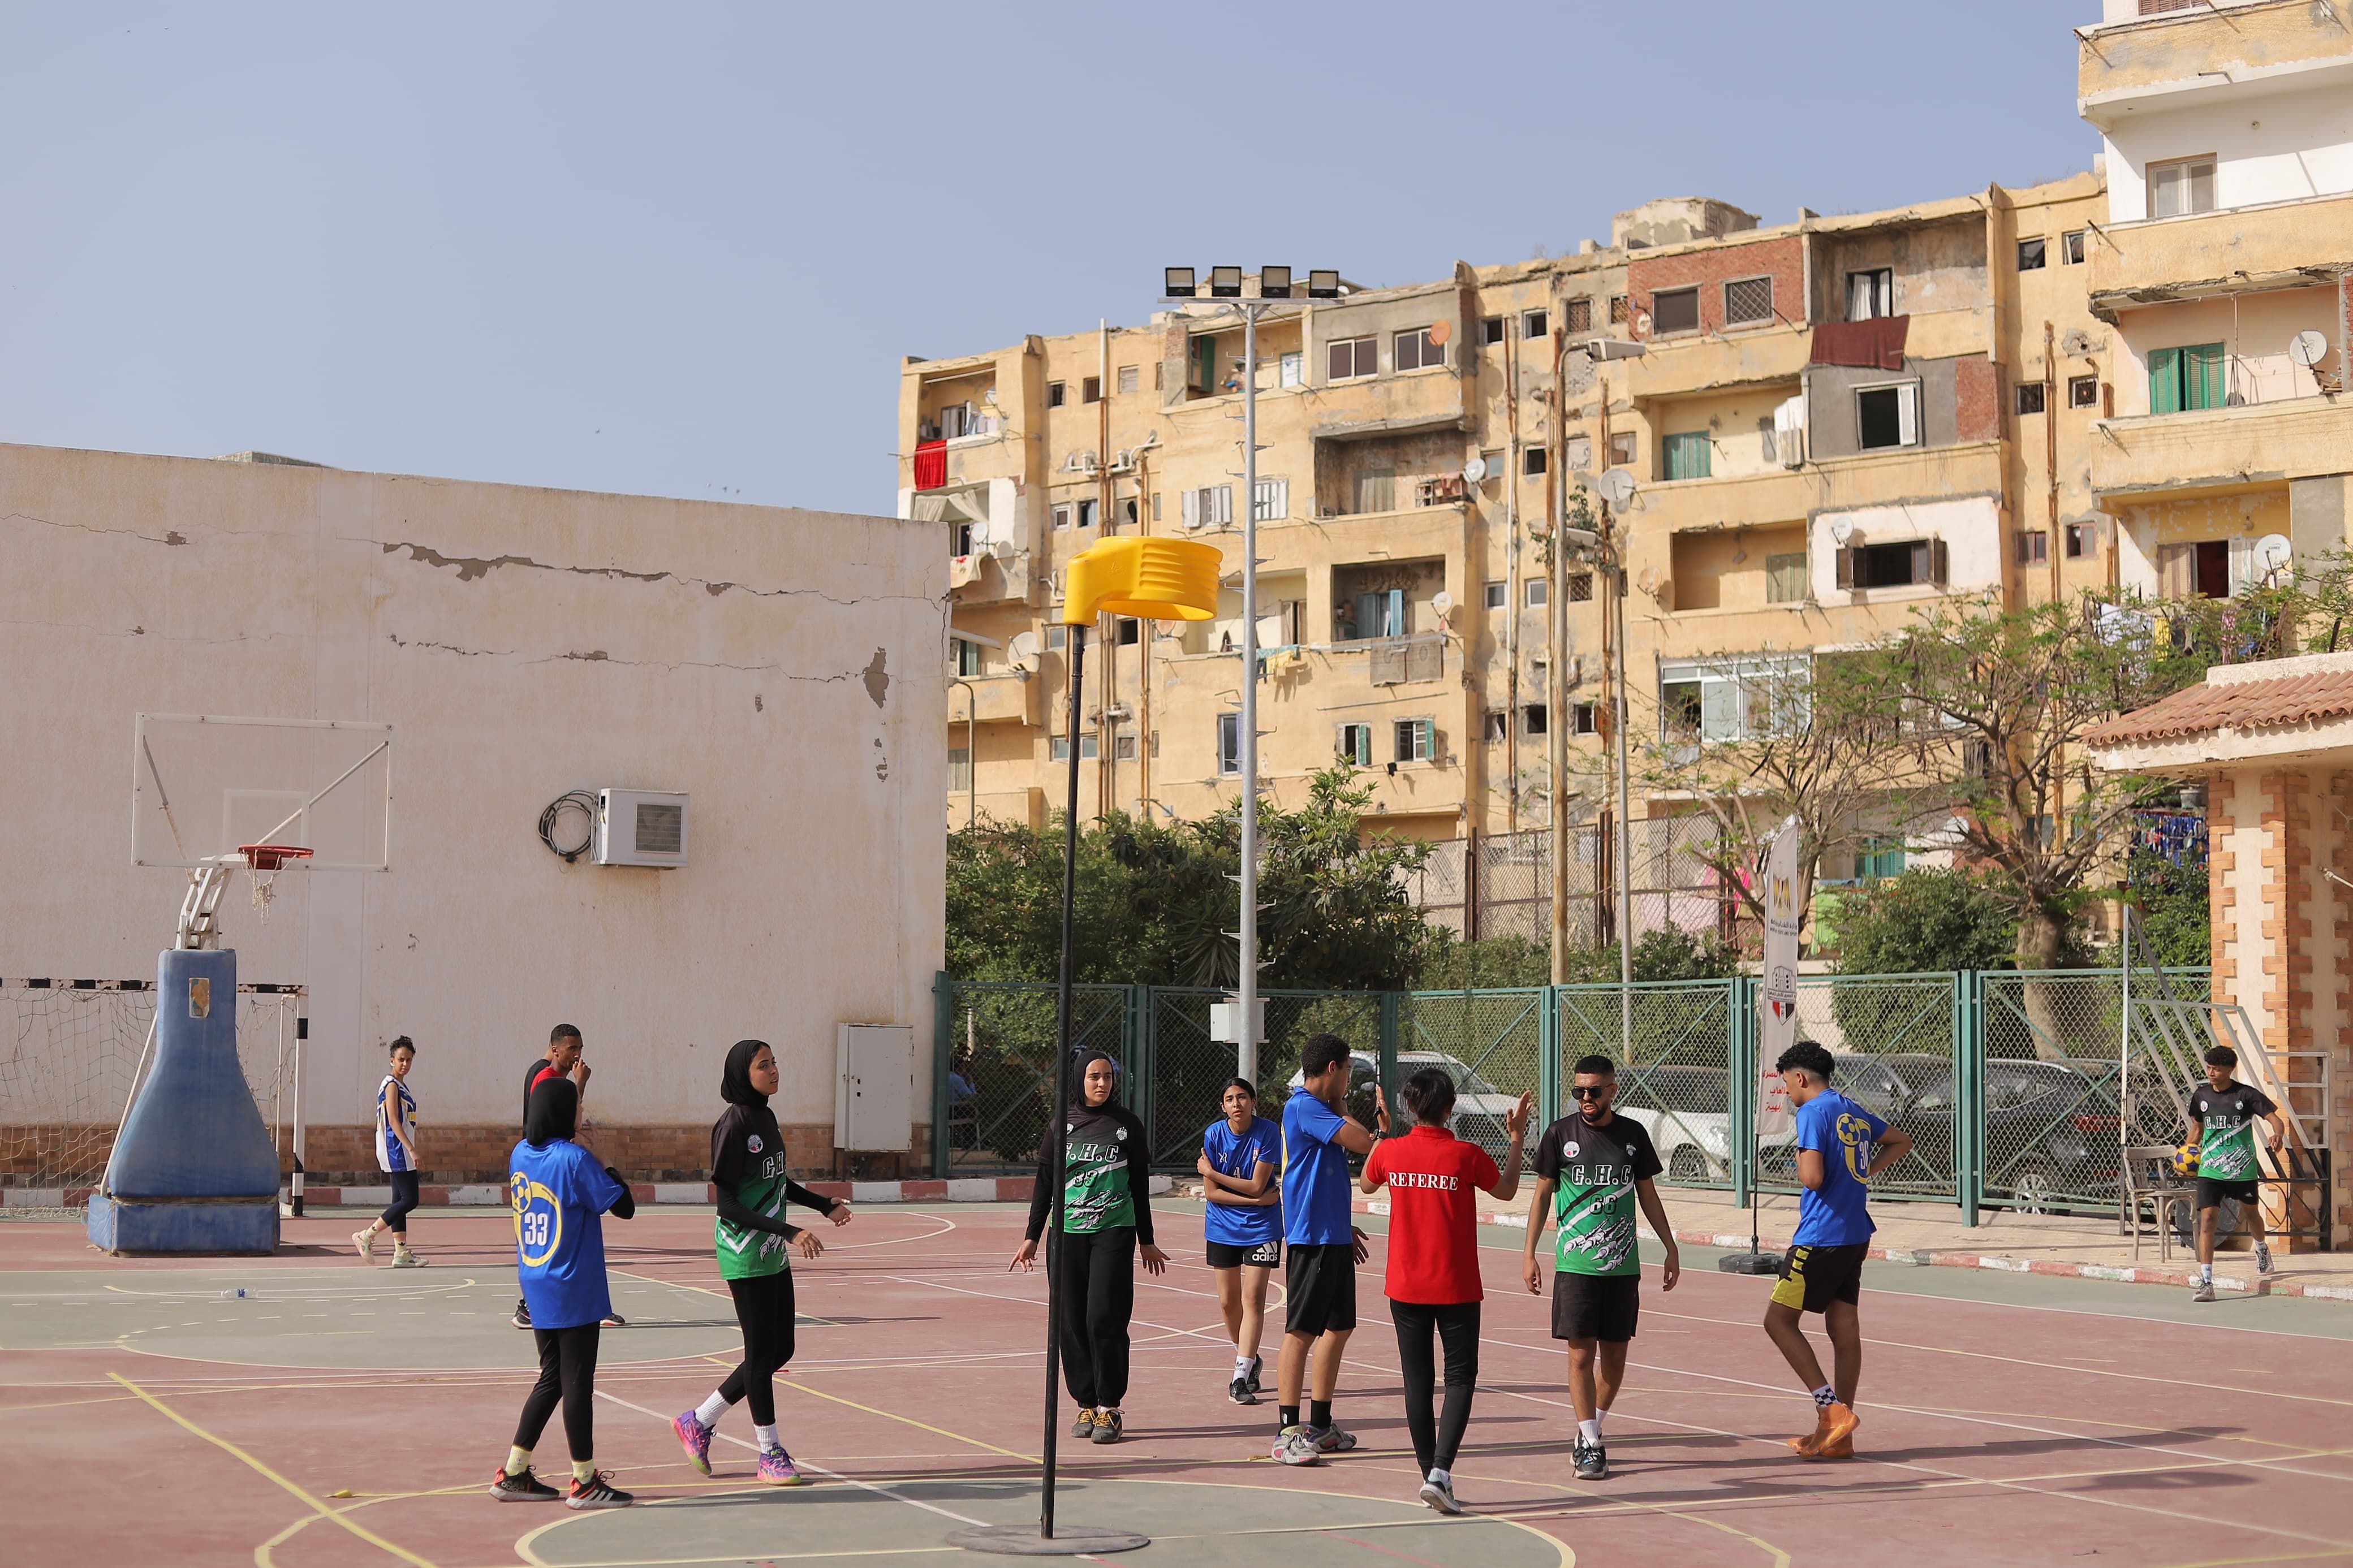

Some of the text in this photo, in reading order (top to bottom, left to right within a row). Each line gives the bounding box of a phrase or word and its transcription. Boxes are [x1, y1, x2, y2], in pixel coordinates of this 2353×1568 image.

[2205, 1116, 2240, 1129] G.H.C
[1072, 1169, 1098, 1187] 33
[1388, 1172, 1458, 1190] REFEREE
[1572, 1165, 1631, 1186] G.H.C
[1589, 1194, 1618, 1214] 66
[524, 1212, 548, 1246] 33
